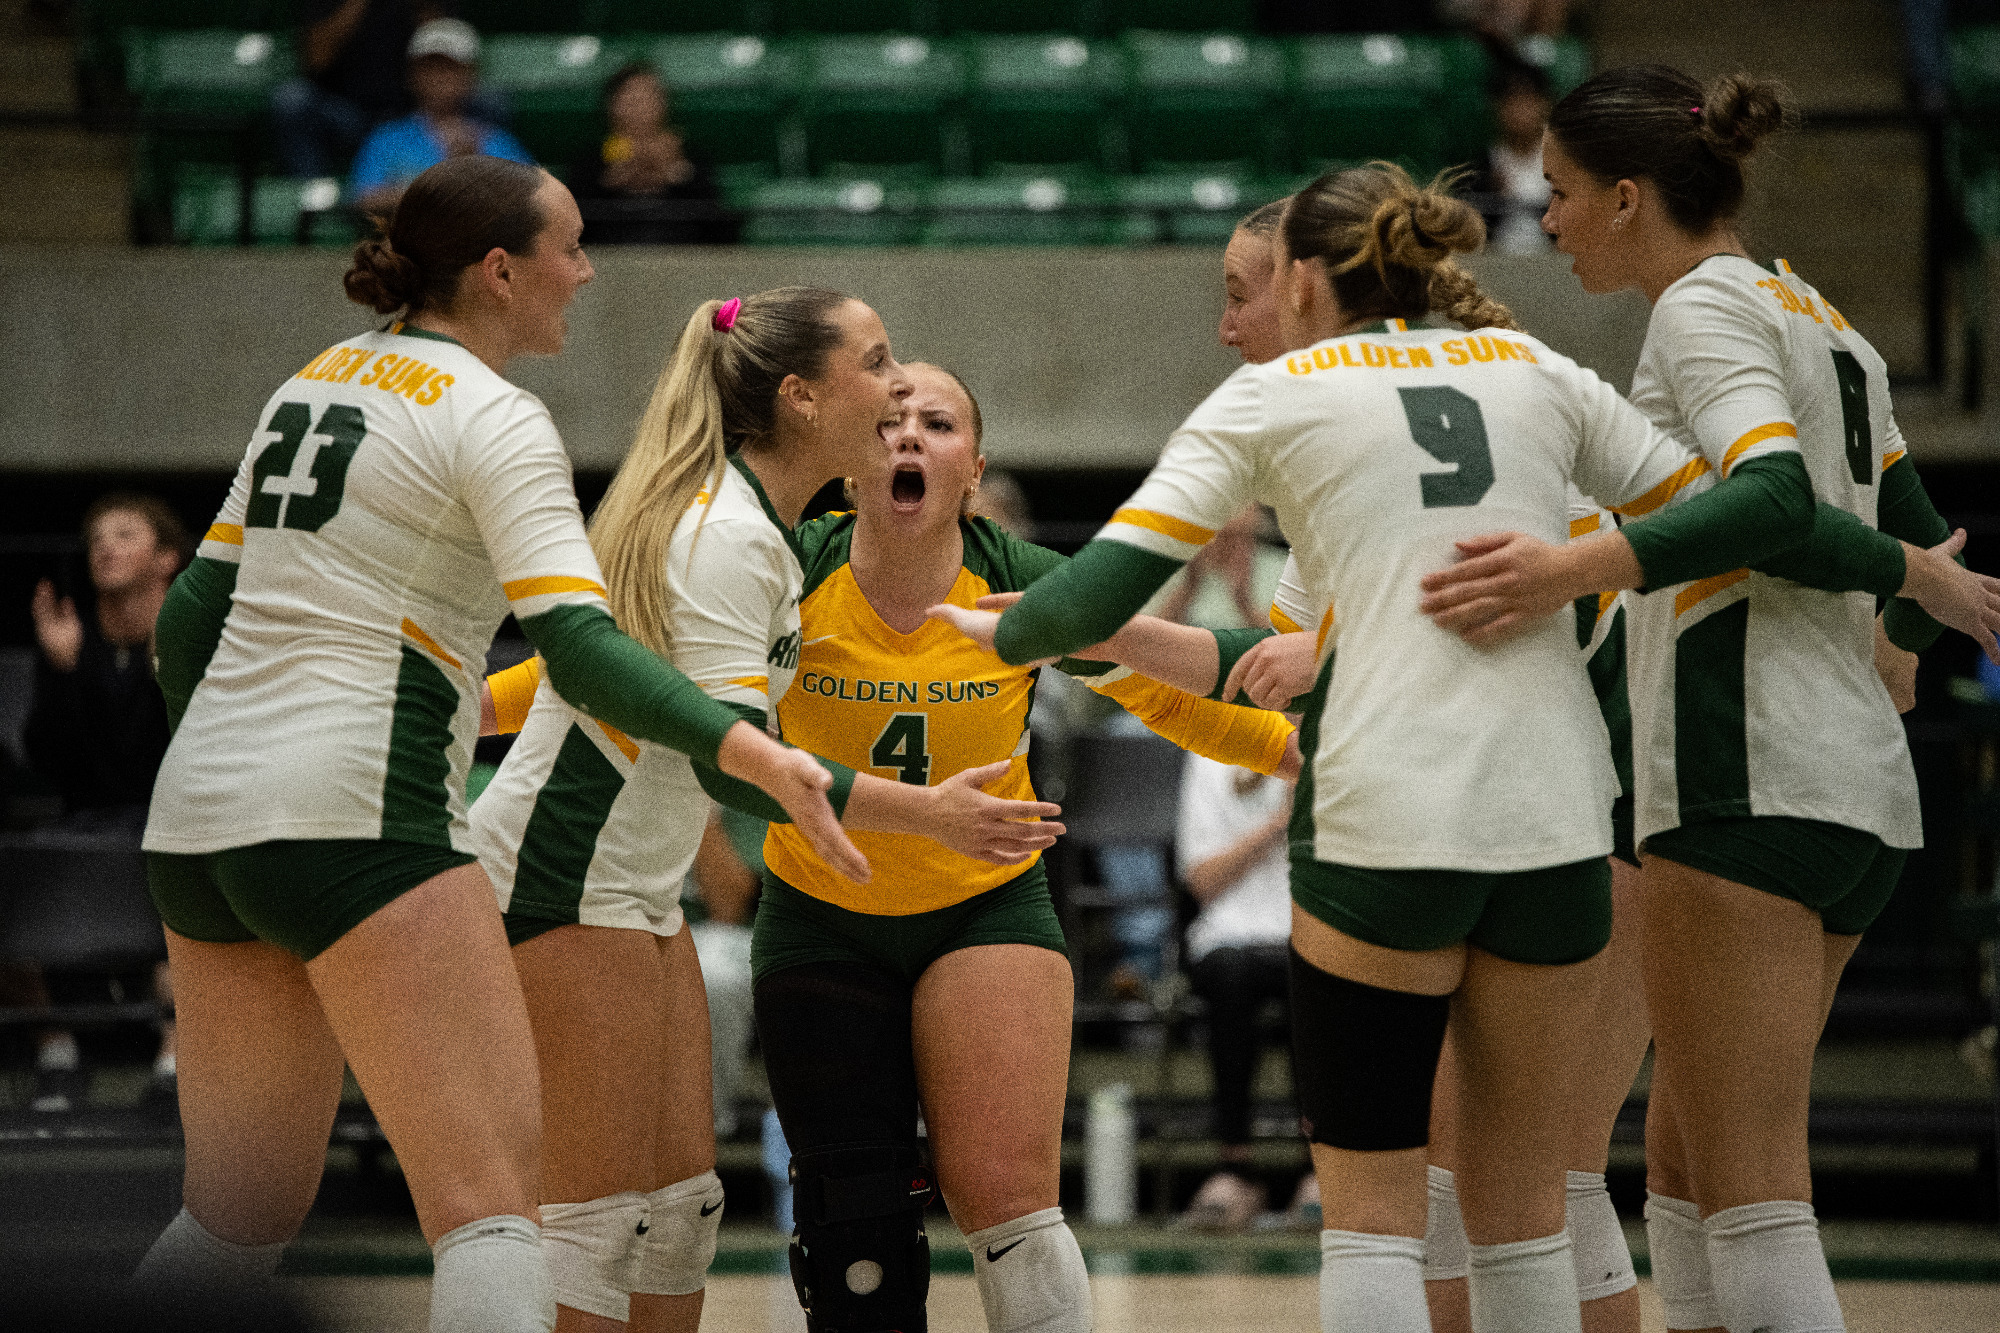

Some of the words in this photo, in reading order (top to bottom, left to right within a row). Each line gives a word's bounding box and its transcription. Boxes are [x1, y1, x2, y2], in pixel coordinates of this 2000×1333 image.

[360, 354, 455, 406] SUNS
[1287, 342, 1434, 375] GOLDEN
[1442, 335, 1539, 364] SUNS
[245, 402, 367, 532] 23
[1396, 384, 1496, 509] 9
[801, 672, 919, 704] GOLDEN
[926, 680, 1000, 704] SUNS
[868, 711, 932, 786] 4
